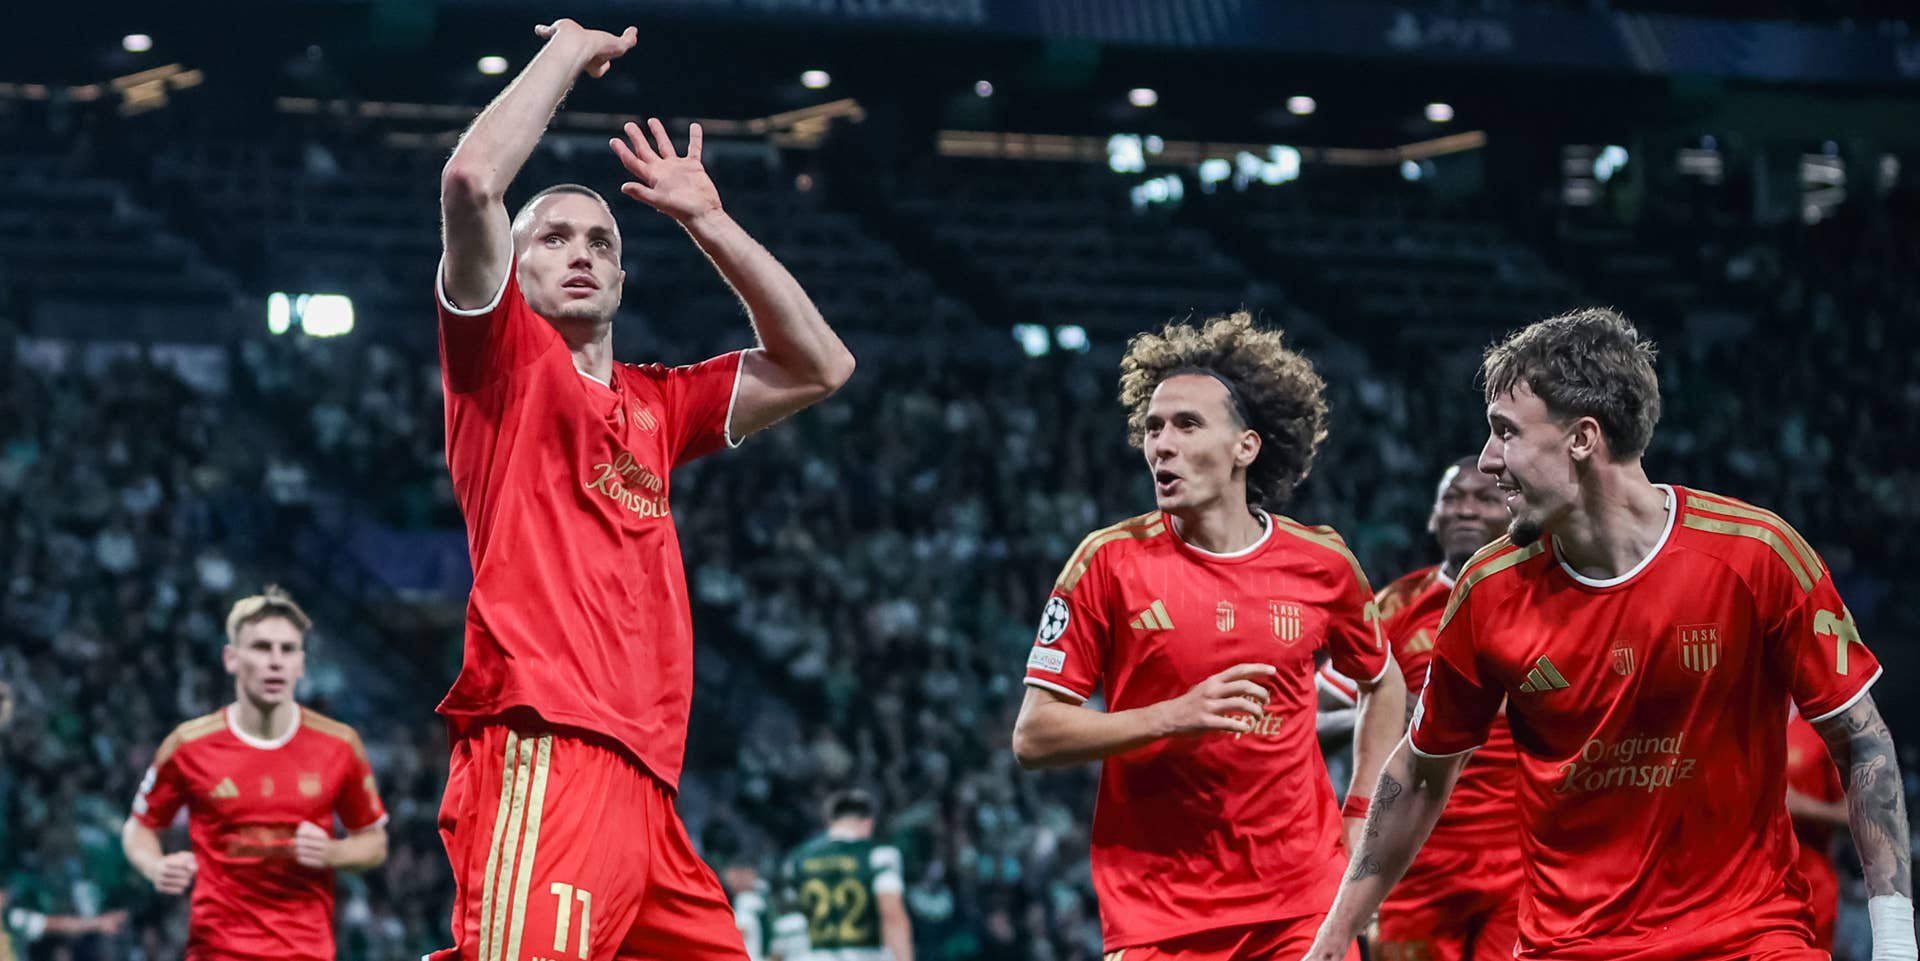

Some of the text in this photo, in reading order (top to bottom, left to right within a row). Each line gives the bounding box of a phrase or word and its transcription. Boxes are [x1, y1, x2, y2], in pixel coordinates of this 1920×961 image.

[614, 452, 662, 492] Oriina
[585, 463, 668, 519] Kornspit
[1273, 604, 1300, 617] LASK
[1682, 629, 1717, 642] LASK
[1224, 712, 1283, 740] spitz
[1582, 731, 1684, 763] Original
[1552, 758, 1697, 793] Kornspiz
[550, 882, 592, 960] 11
[801, 877, 868, 943] 22
